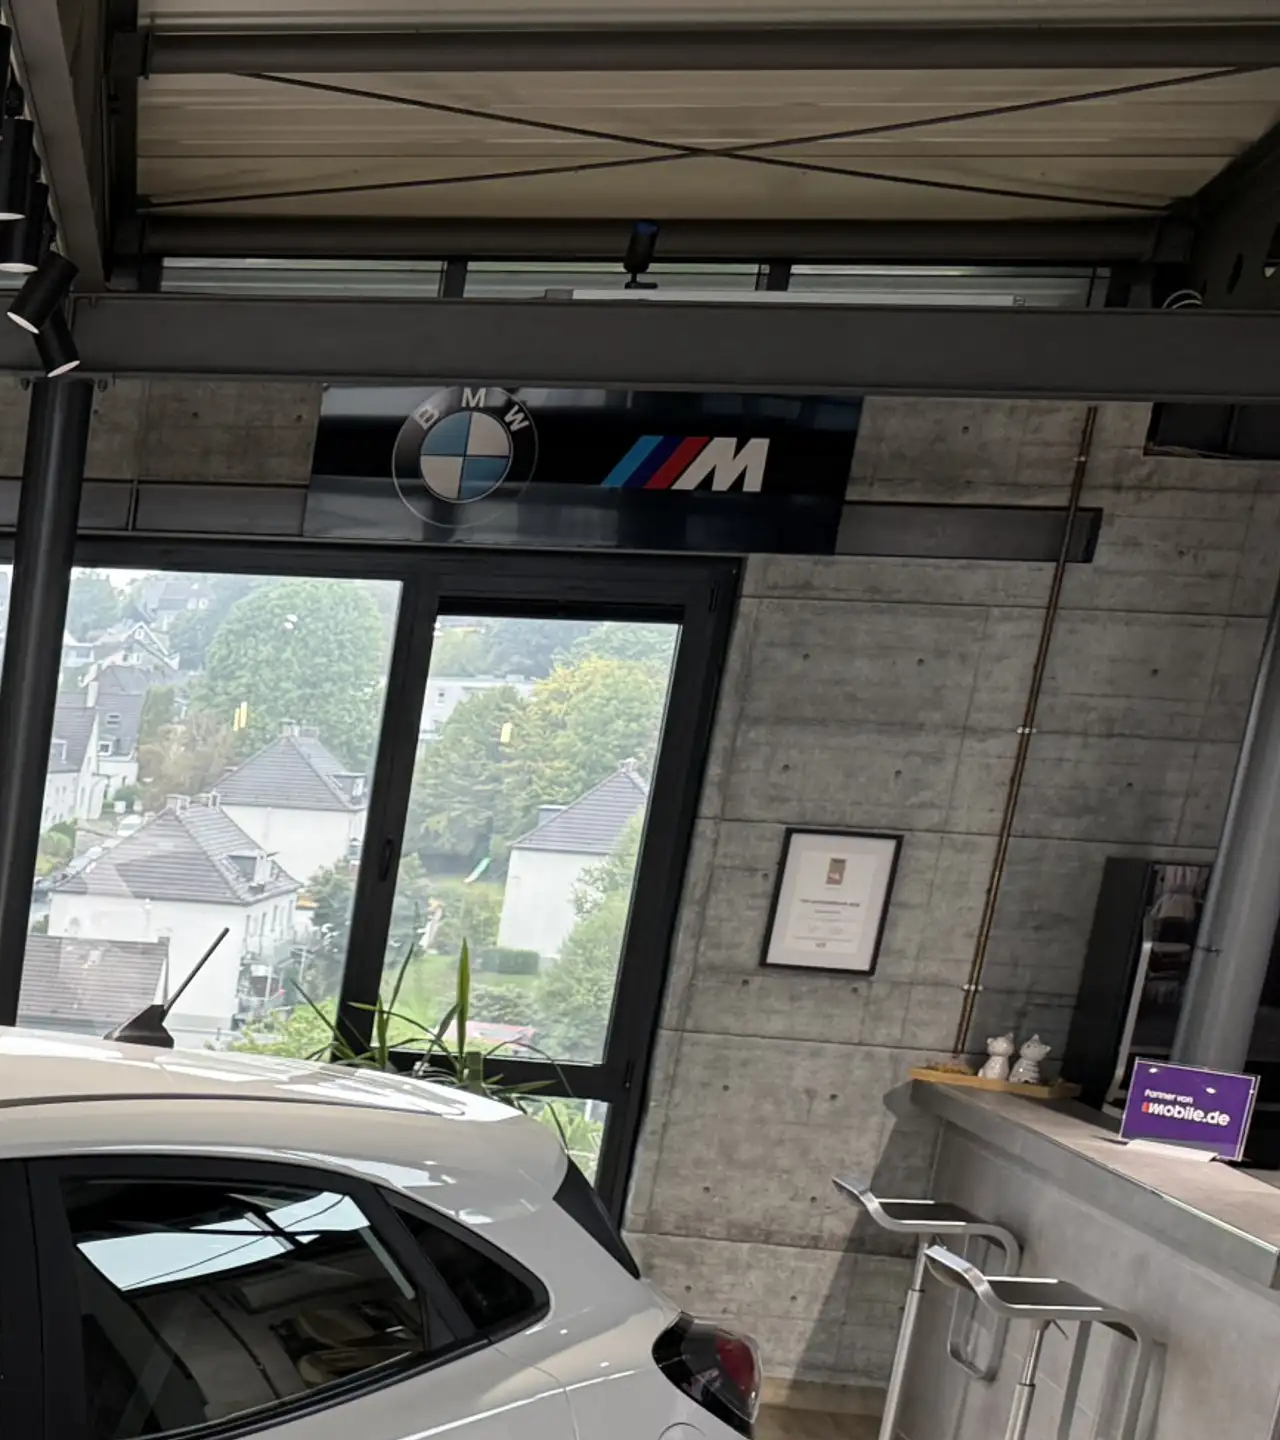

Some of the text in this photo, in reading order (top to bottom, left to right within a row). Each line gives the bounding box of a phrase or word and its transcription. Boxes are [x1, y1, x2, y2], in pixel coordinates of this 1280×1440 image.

[412, 387, 531, 433] BMW
[1177, 1095, 1194, 1104] von
[1148, 1102, 1231, 1126] mobile.de
